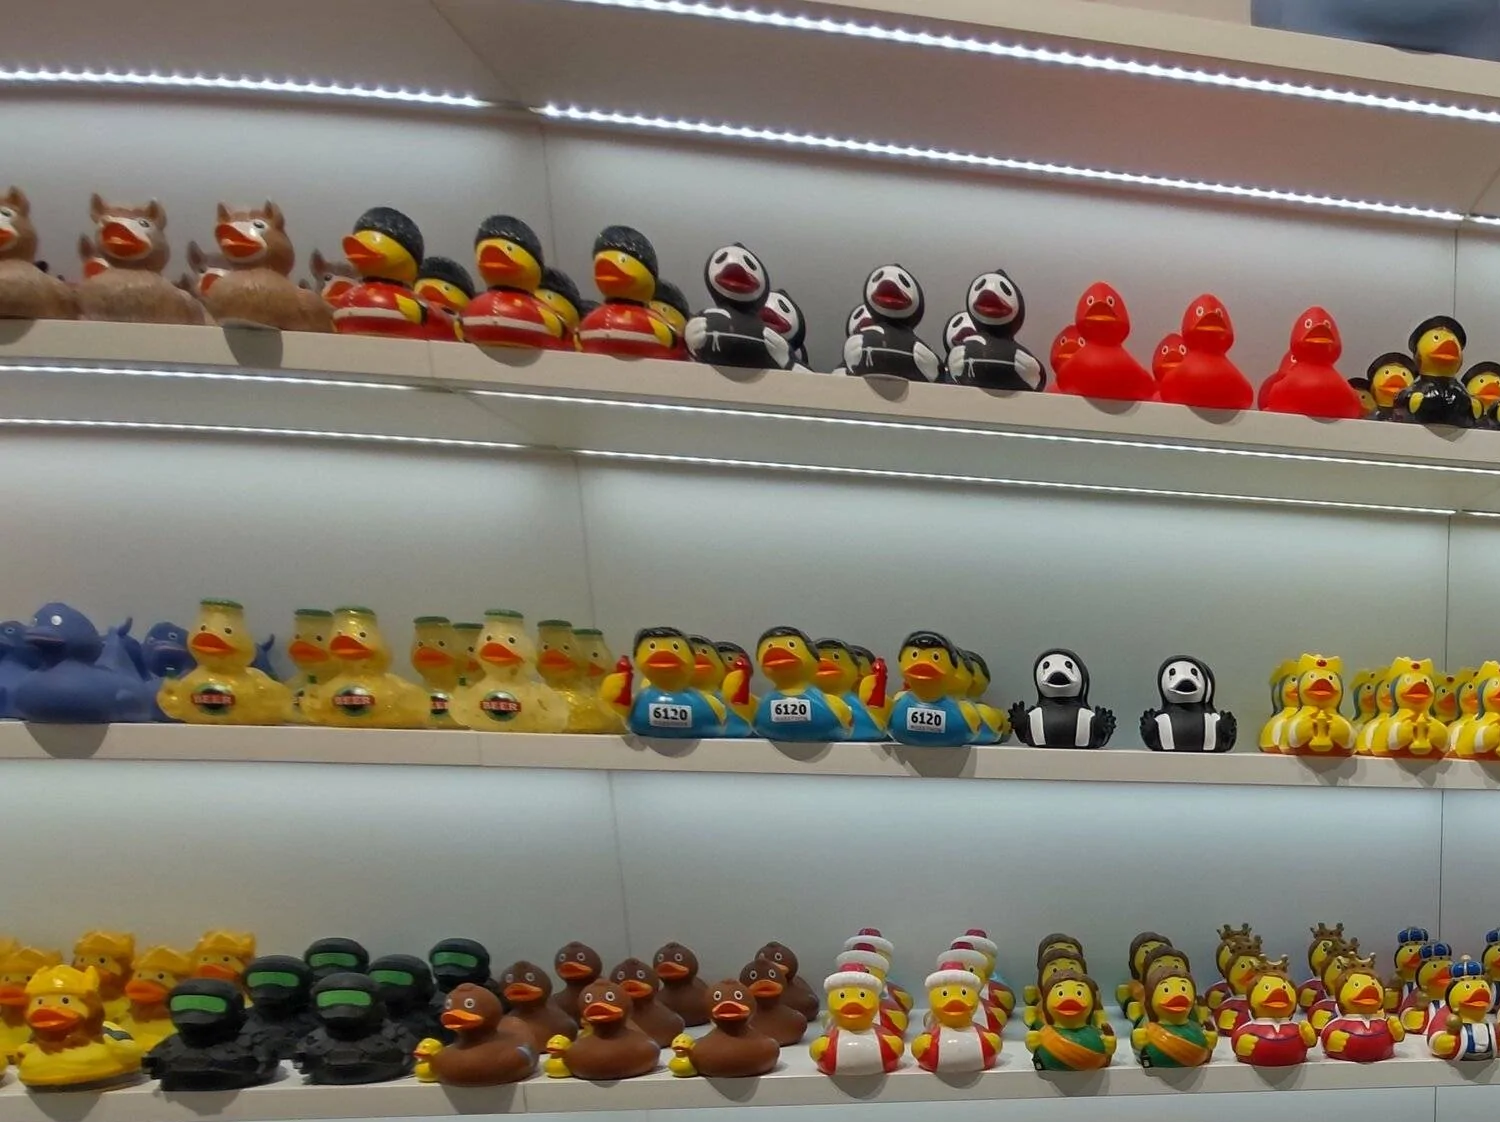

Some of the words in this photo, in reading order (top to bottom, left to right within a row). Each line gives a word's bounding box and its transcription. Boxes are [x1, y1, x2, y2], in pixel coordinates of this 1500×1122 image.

[482, 701, 518, 711] BEER
[775, 703, 807, 716] 6120
[653, 707, 688, 721] 6120
[911, 711, 942, 727] 6120
